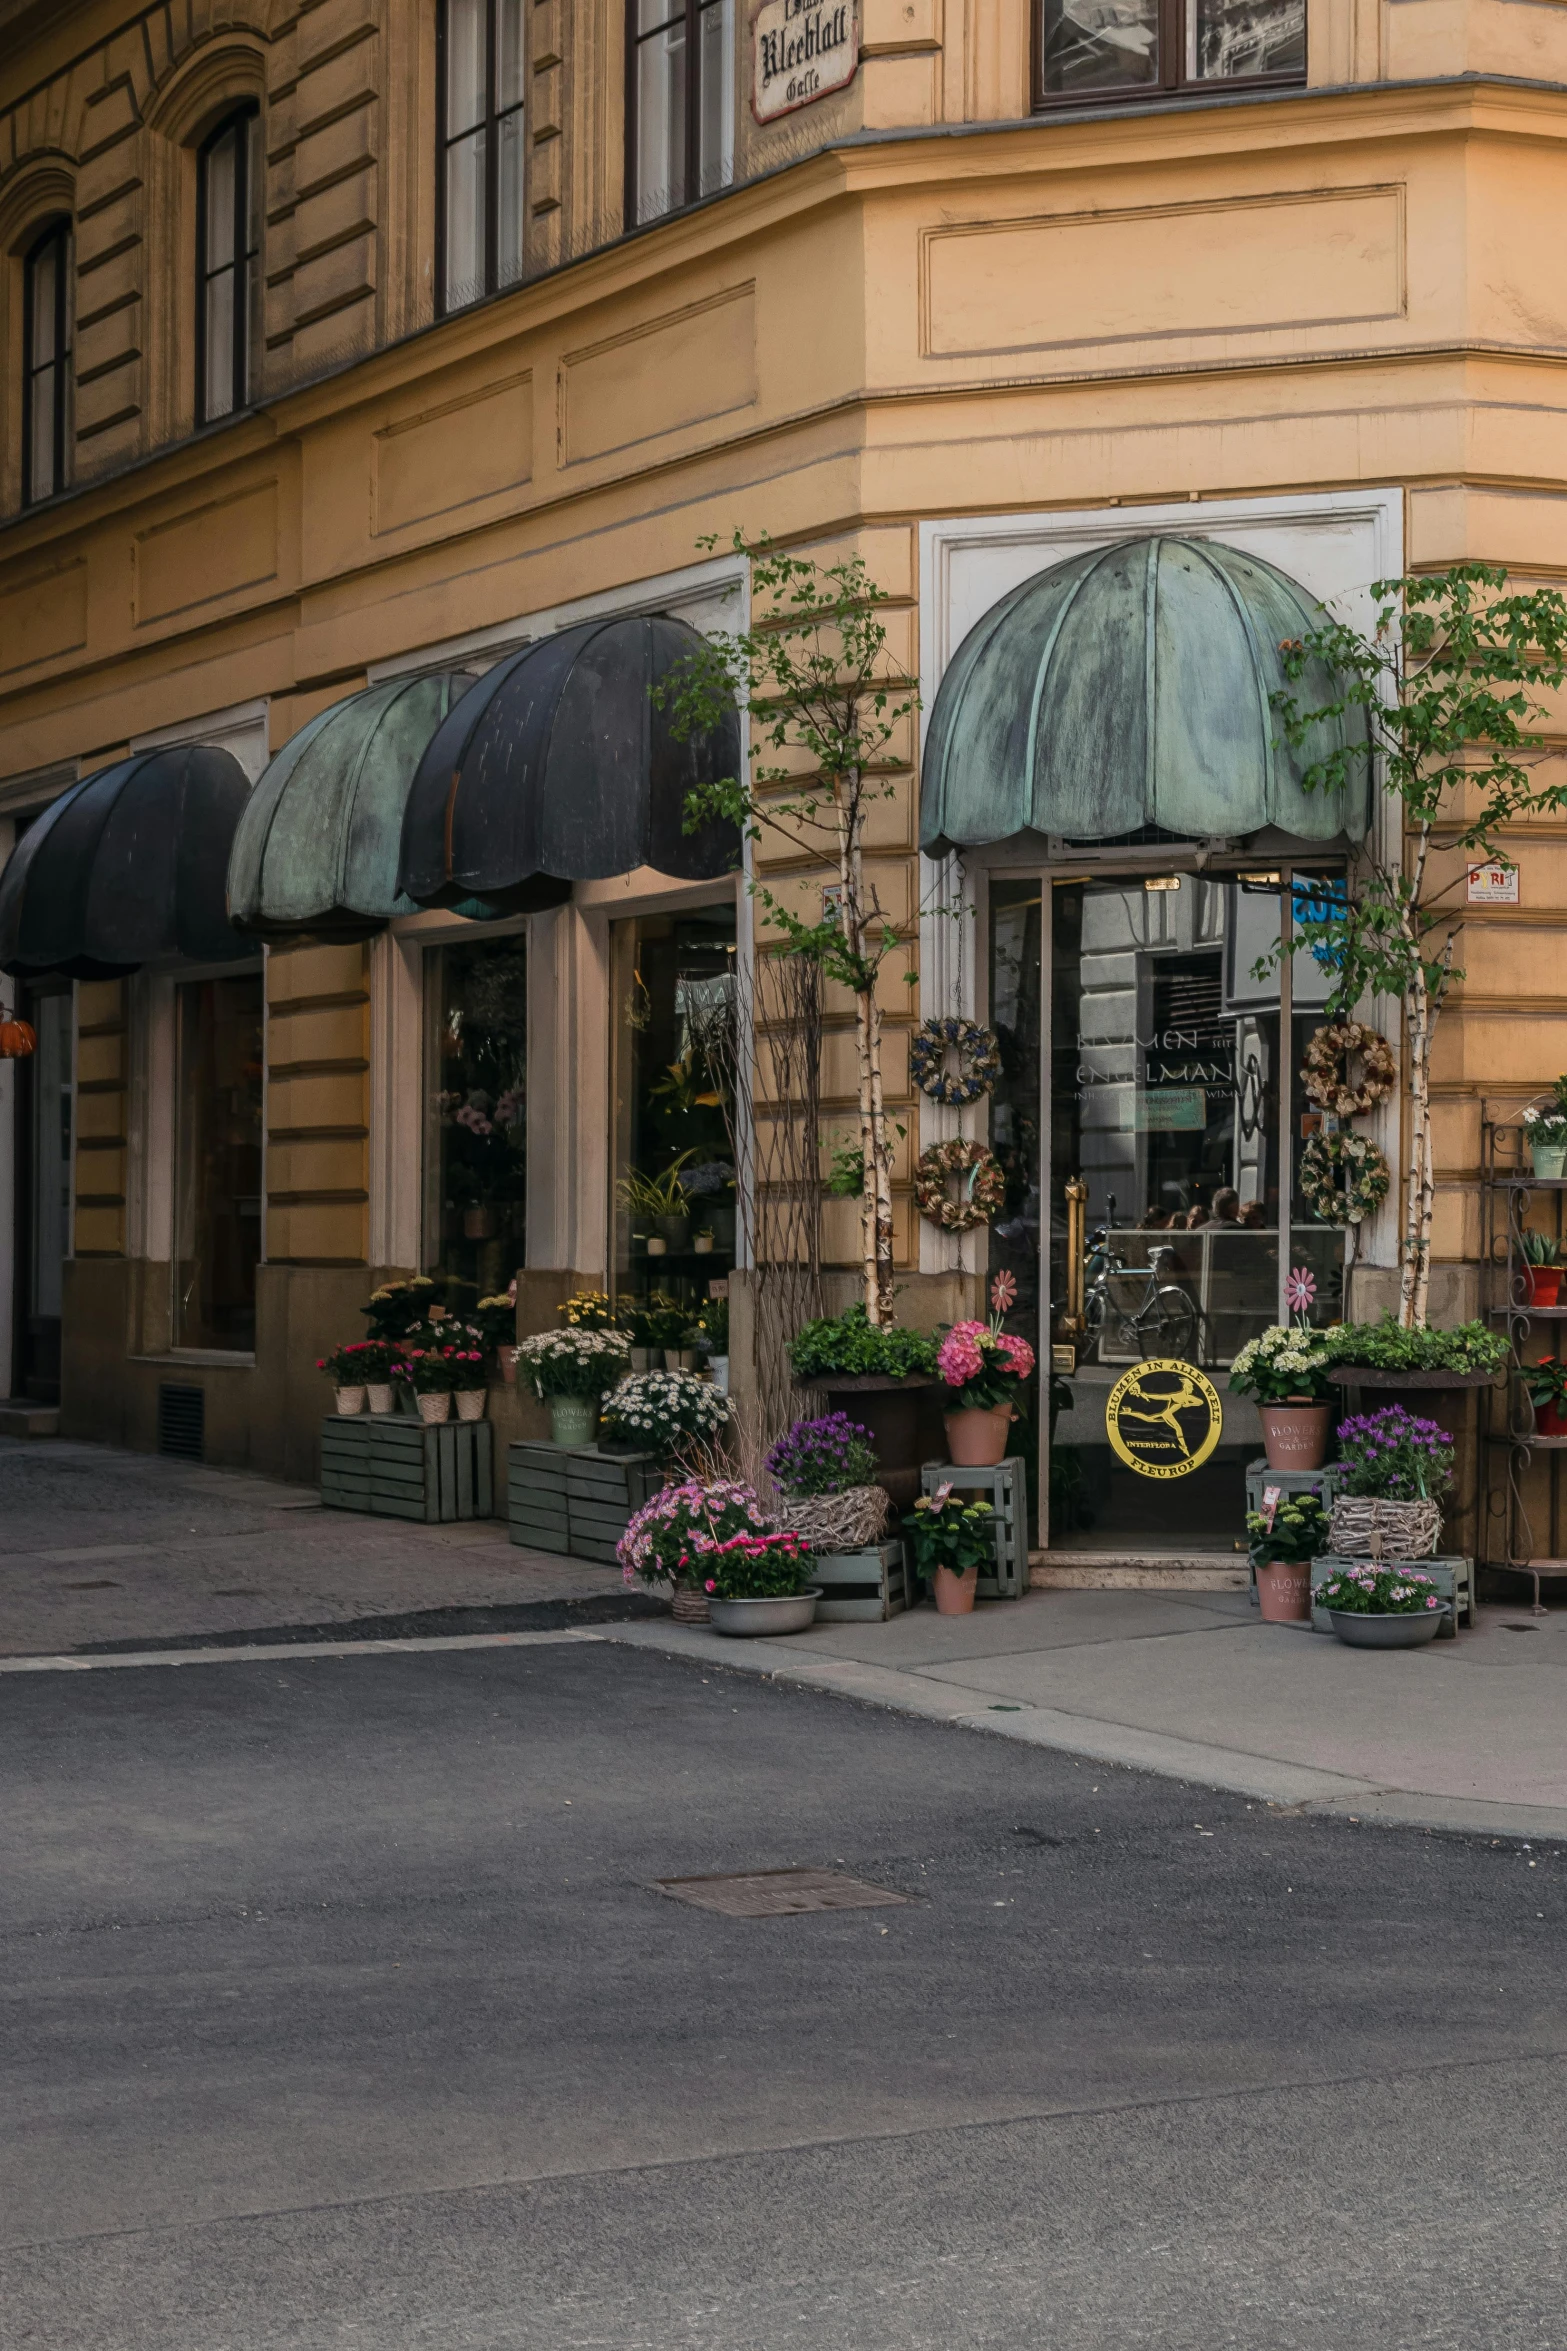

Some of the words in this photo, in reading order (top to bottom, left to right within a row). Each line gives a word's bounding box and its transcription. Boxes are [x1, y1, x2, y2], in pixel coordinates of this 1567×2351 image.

[761, 5, 847, 88] Kleeblatt
[786, 68, 820, 101] Gasse
[1108, 1368, 1142, 1422] BLUMEN
[1146, 1361, 1164, 1371] IN
[1169, 1362, 1204, 1383] ALLE
[1205, 1384, 1221, 1424] WELT
[1270, 1423, 1322, 1438] FLOWERS
[1126, 1440, 1177, 1449] INTERFLORA
[1279, 1441, 1314, 1451] GARDEN
[1130, 1458, 1195, 1477] FLEUROP
